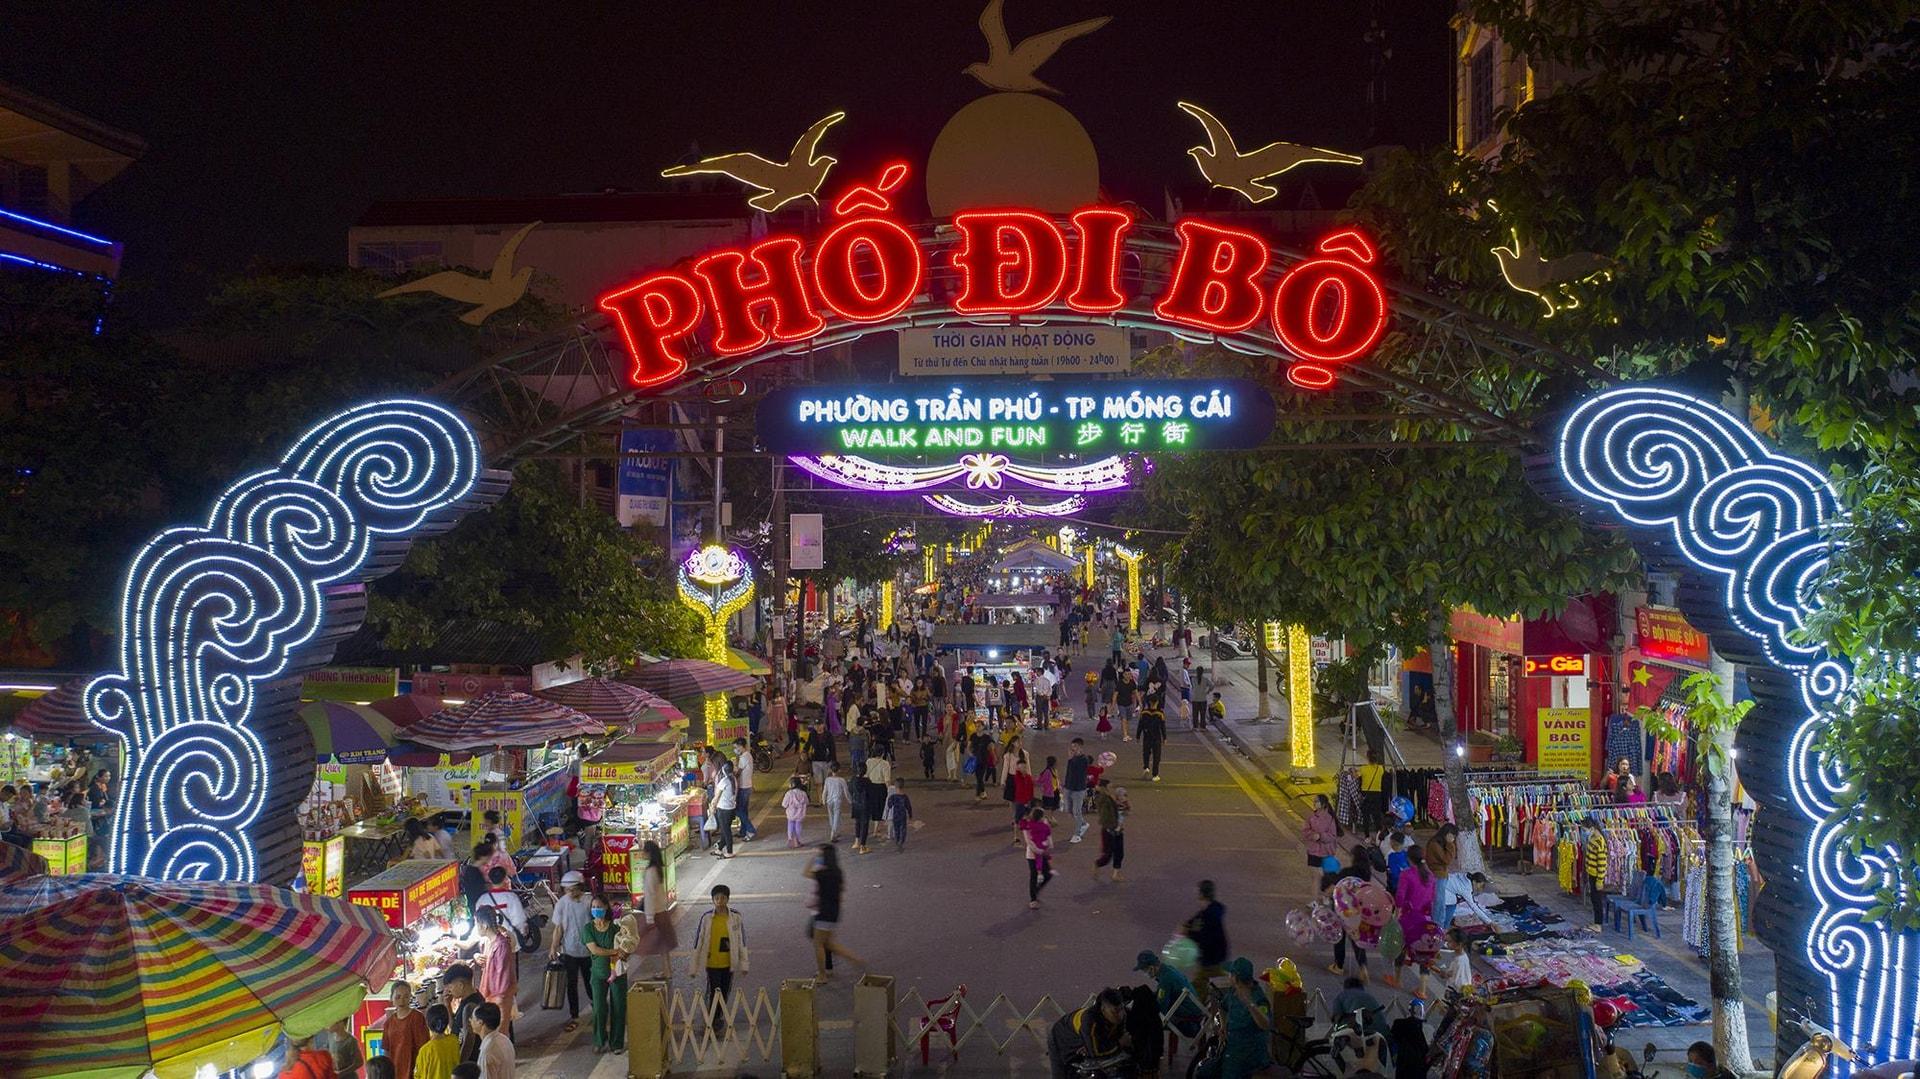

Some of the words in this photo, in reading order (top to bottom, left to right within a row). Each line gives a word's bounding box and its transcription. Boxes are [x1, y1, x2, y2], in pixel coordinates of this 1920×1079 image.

[598, 161, 922, 387] PHỐ
[951, 207, 1133, 317] ĐI
[1153, 217, 1388, 390] BỘ
[932, 331, 966, 348] THỜI
[970, 334, 1006, 348] GIAN
[1012, 333, 1049, 350] HOẠT
[1053, 331, 1096, 350] ĐỘNG
[799, 394, 909, 423] PHƯỜNG
[915, 387, 983, 422] TRẦN
[988, 392, 1043, 421] PHÚ
[1065, 397, 1096, 420] TP
[1102, 390, 1184, 419] MÓNG
[1190, 389, 1232, 419] CÁI
[840, 427, 918, 448] WALK
[924, 427, 984, 448] AND
[991, 426, 1046, 447] FUN
[1551, 656, 1584, 671] Gia
[1543, 718, 1586, 729] VÀNG
[1549, 733, 1581, 744] BẠC
